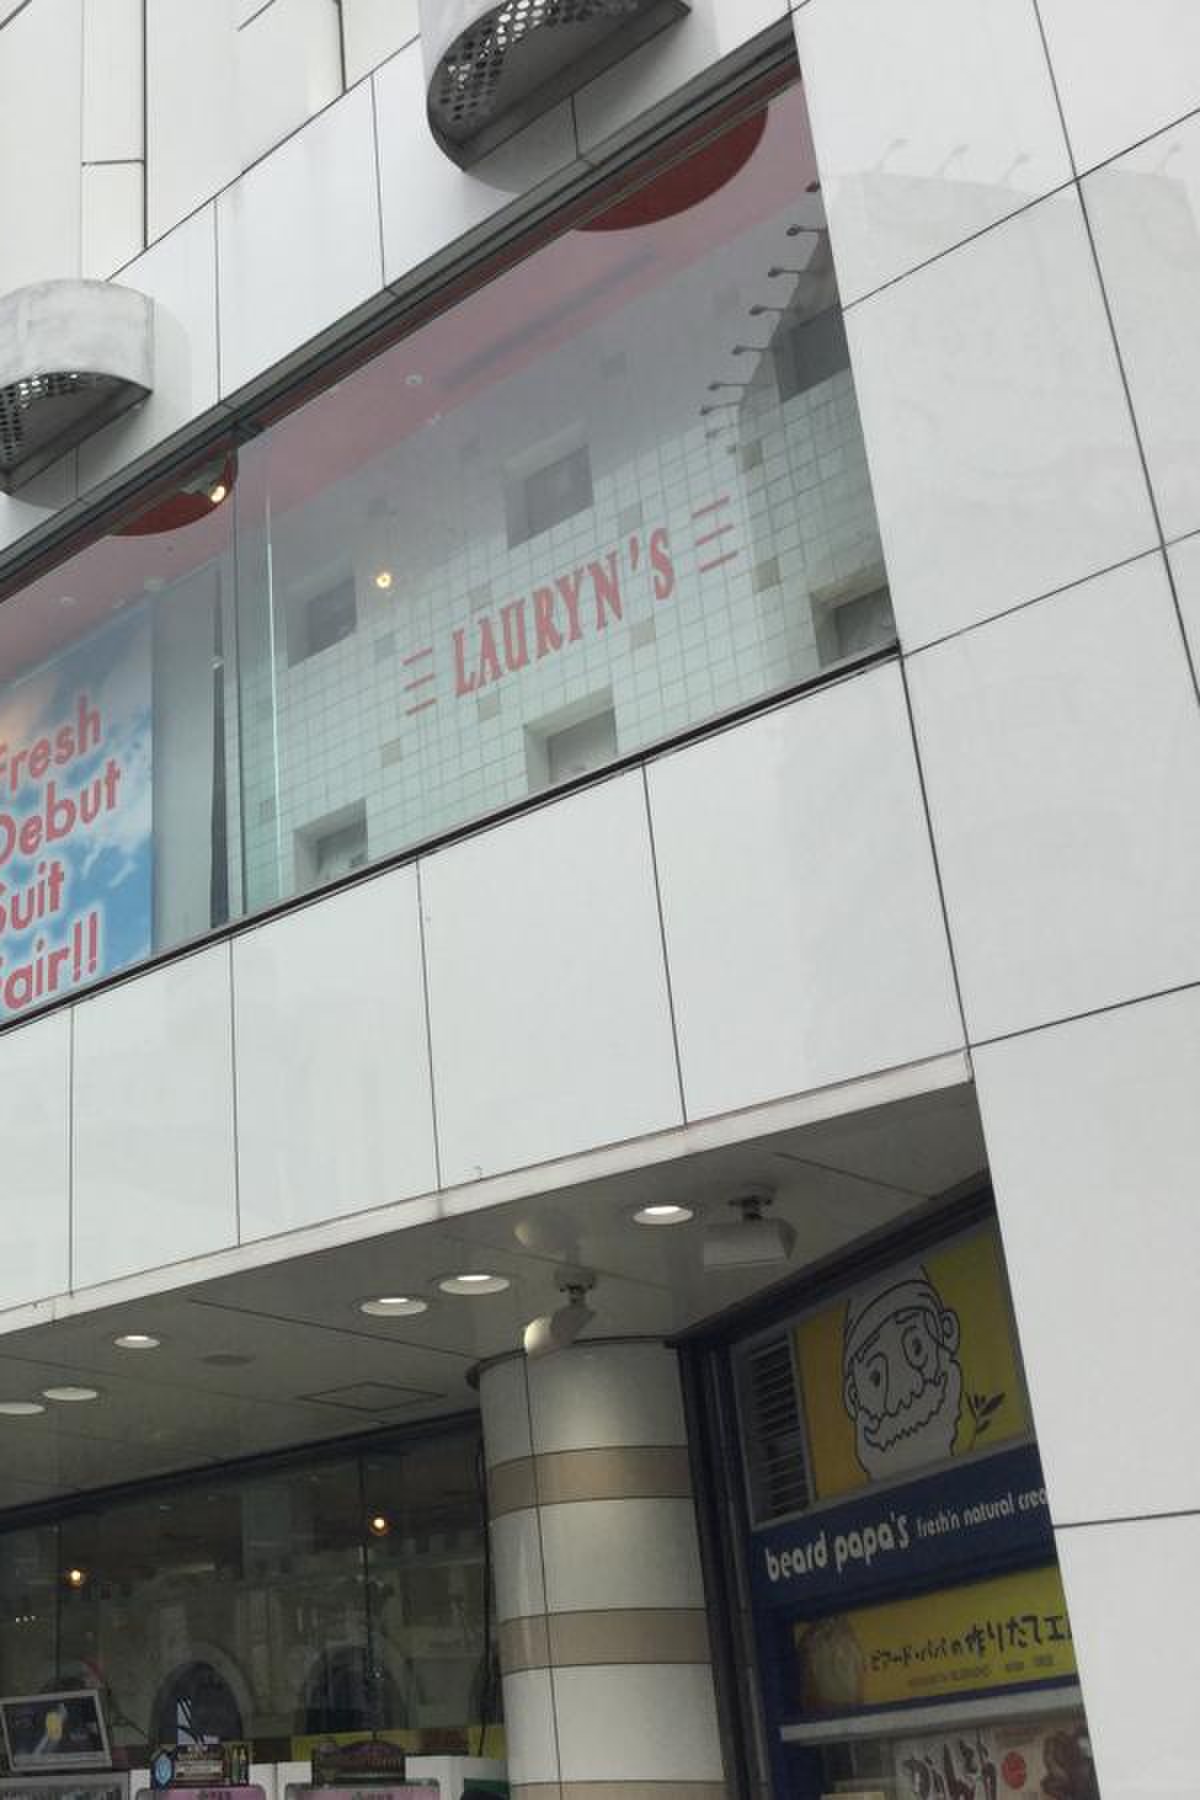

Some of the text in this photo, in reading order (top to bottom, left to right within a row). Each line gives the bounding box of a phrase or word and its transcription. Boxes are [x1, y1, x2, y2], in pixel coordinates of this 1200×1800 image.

[450, 527, 676, 699] LAURYN'S
[764, 1531, 828, 1582] beard
[964, 1493, 1015, 1527] natural
